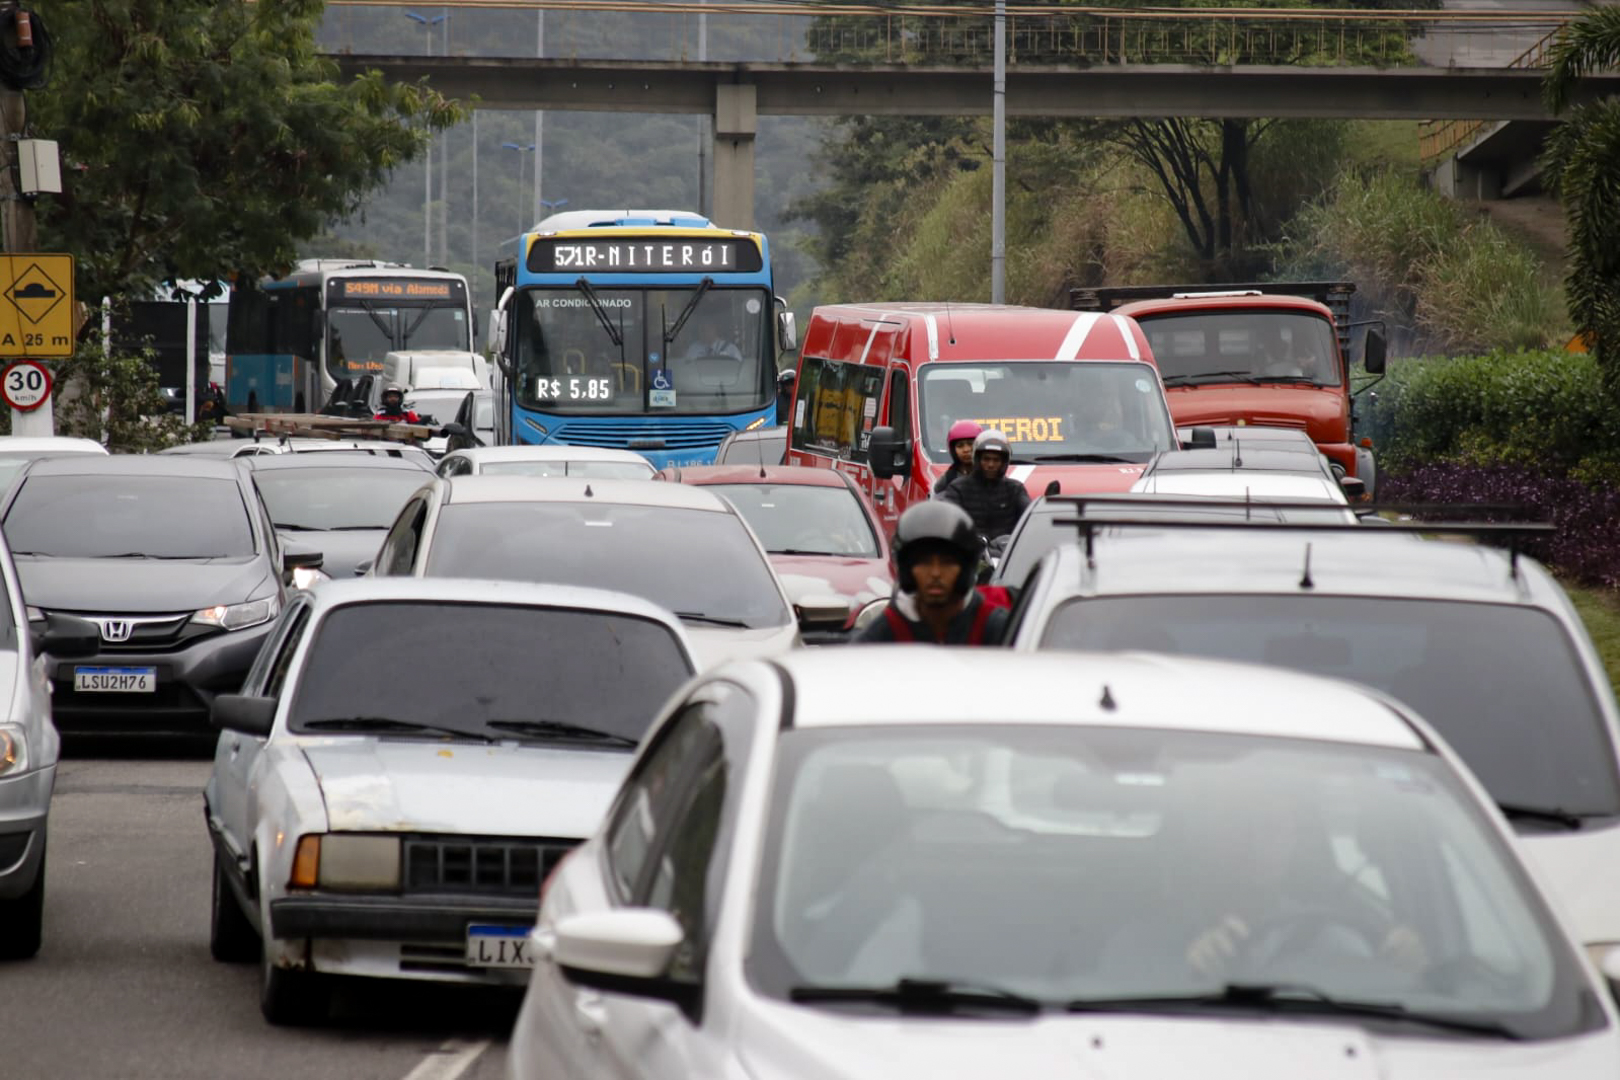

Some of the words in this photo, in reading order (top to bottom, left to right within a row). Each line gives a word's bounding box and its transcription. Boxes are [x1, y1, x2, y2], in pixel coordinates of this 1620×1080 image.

[345, 282, 379, 294] 549M
[382, 283, 402, 294] via
[536, 299, 550, 308] AR
[552, 299, 632, 308] CONDICONADO
[2, 333, 16, 346] A
[25, 333, 43, 346] 25
[52, 335, 69, 346] m
[9, 370, 42, 391] 30
[537, 379, 561, 398] R$
[570, 379, 609, 398] 5,85
[14, 393, 37, 401] km/h
[972, 417, 1064, 442] TEROI
[81, 675, 147, 690] LSU2H76
[479, 939, 534, 964] LIX
